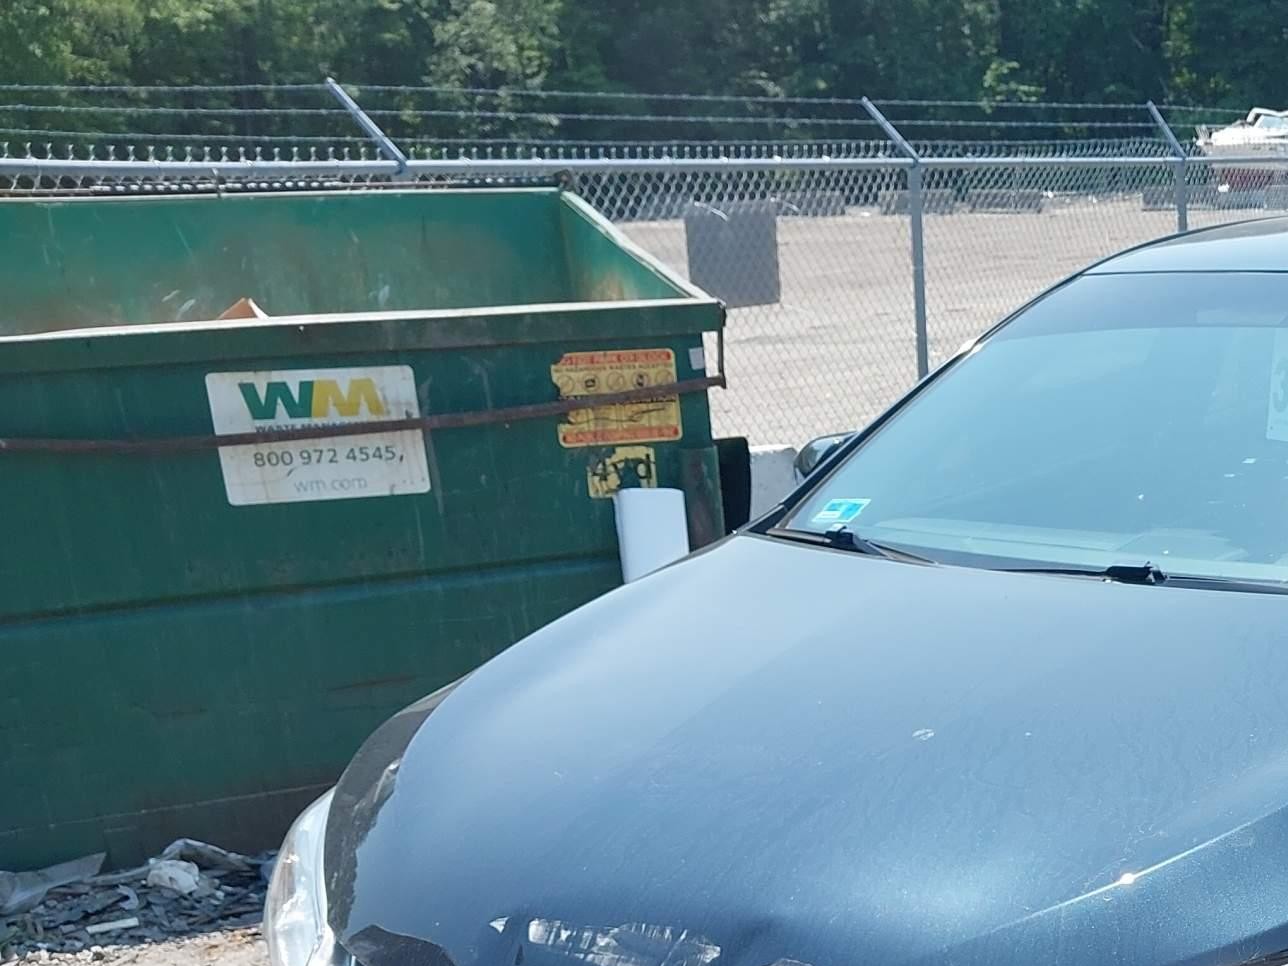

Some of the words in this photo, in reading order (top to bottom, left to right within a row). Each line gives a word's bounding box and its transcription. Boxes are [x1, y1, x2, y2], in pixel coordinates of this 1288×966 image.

[238, 377, 386, 420] WM
[253, 451, 294, 468] 800
[299, 448, 339, 466] 972
[293, 477, 367, 493] wm.com
